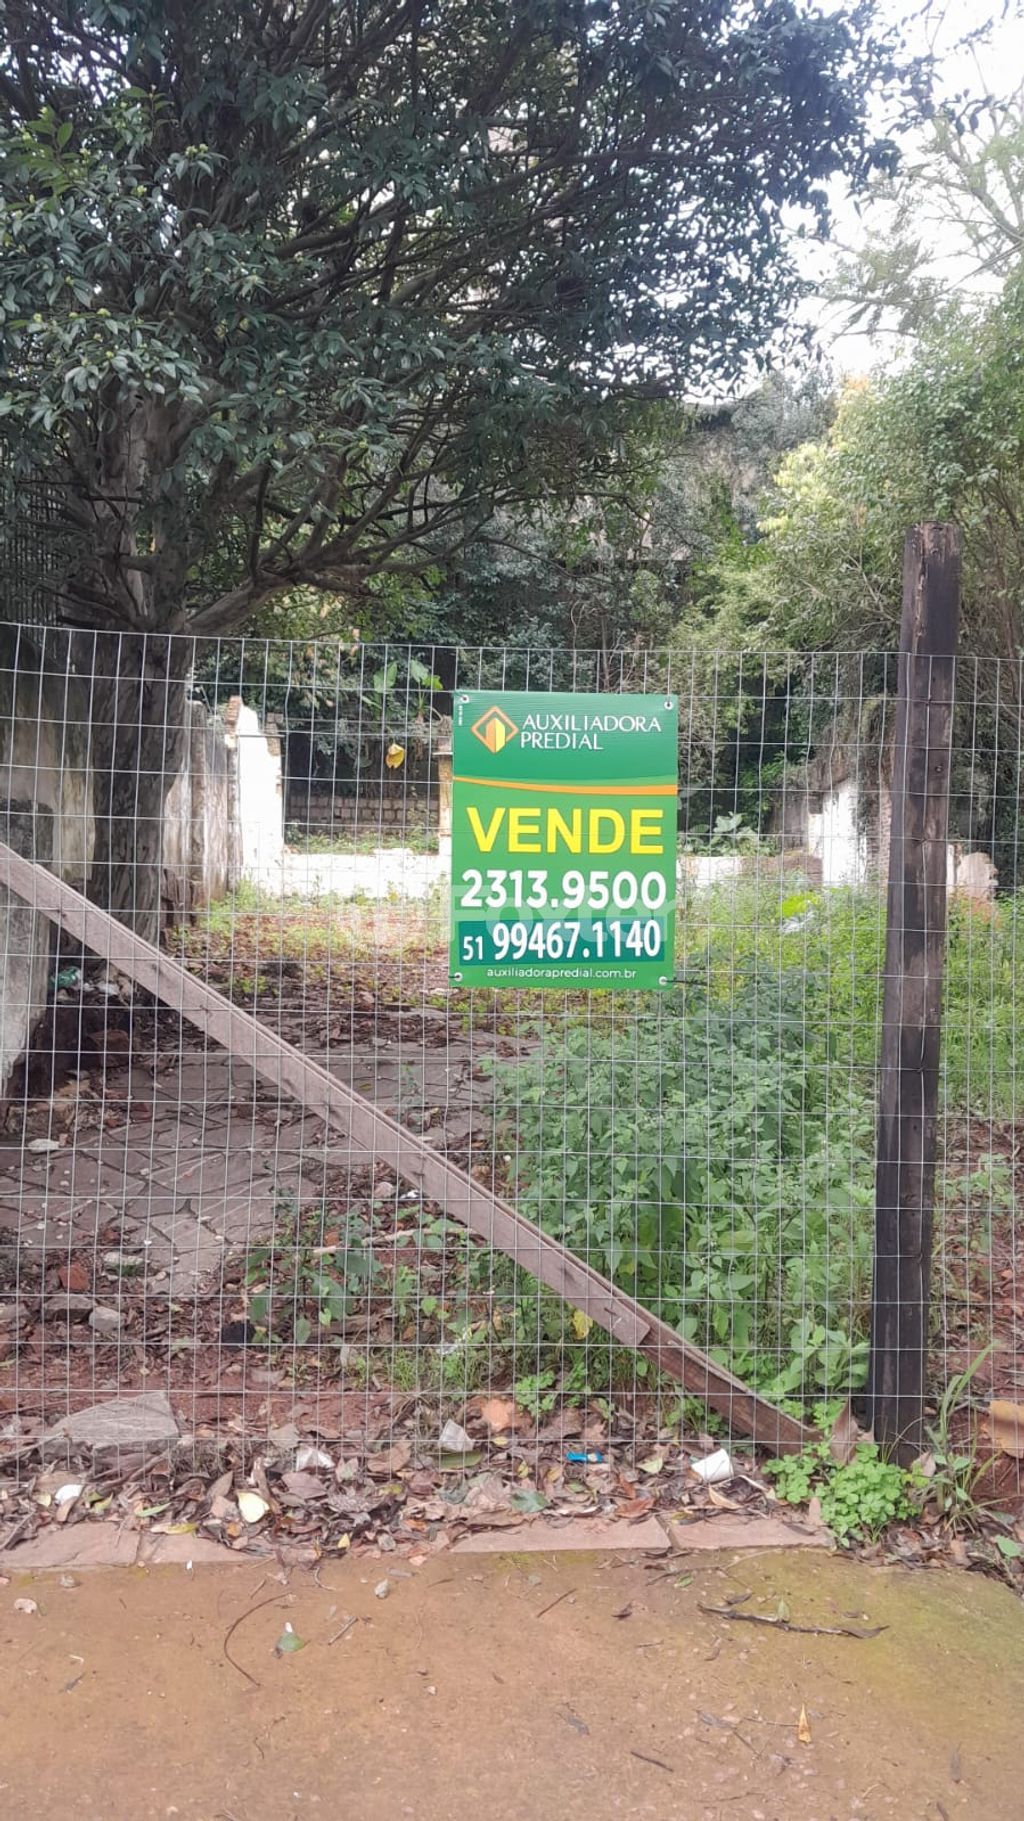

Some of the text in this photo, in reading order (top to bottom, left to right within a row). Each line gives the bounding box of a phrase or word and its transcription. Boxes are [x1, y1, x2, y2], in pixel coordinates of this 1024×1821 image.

[522, 714, 661, 732] AUXILIADORA
[520, 732, 604, 750] PREDIAL
[466, 807, 664, 855] VENDE
[460, 869, 667, 910] 2313.9500
[463, 919, 661, 961] 51 99467.1140
[486, 967, 637, 980] auxiliadorapredial.com.br
